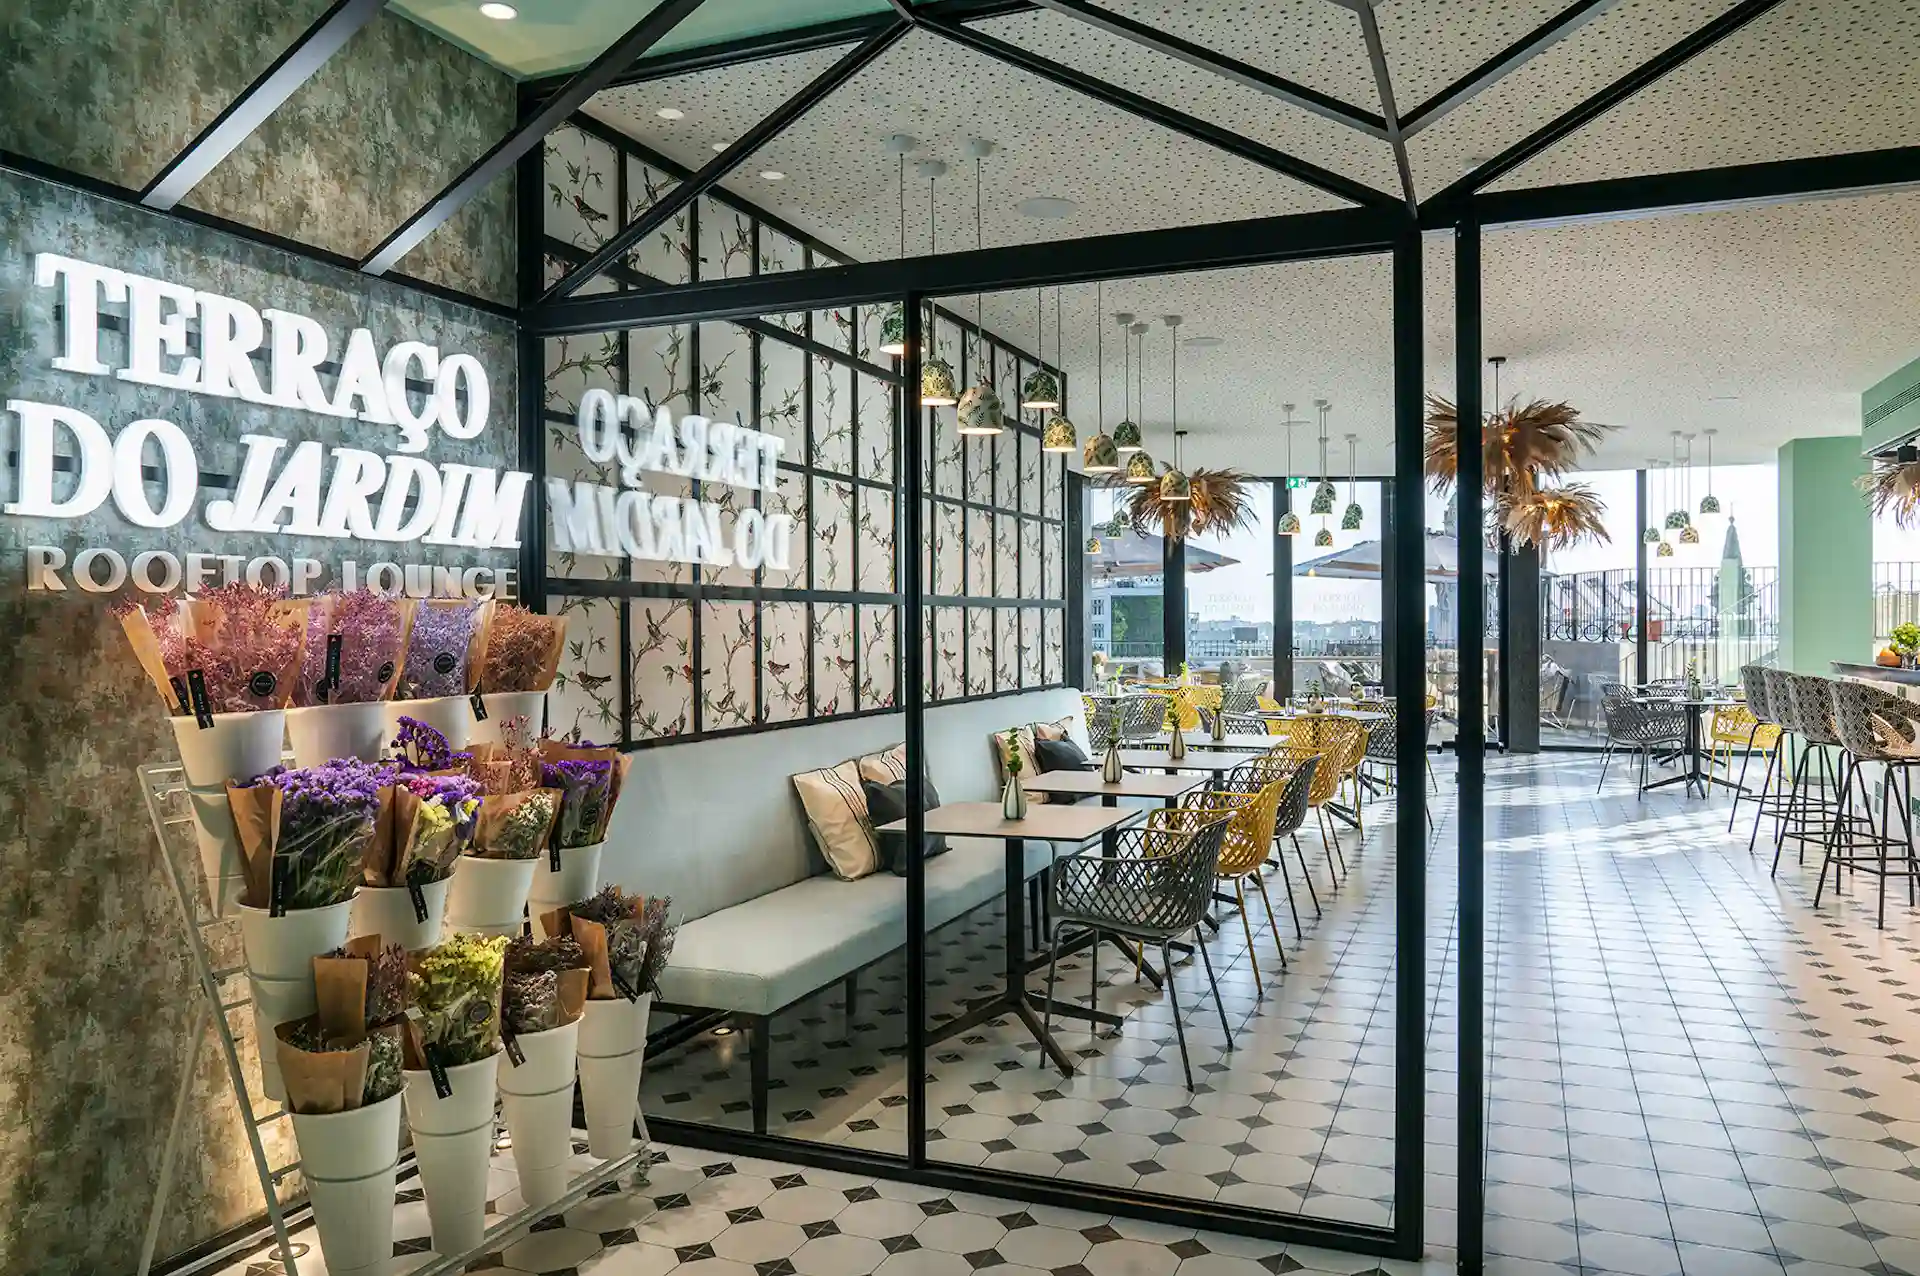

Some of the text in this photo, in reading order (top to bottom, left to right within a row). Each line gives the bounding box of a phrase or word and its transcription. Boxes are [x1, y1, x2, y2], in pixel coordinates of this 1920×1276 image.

[34, 252, 490, 452] TERRAÇO
[4, 399, 533, 549] DO JARDIM
[28, 546, 322, 596] ROOFTOP
